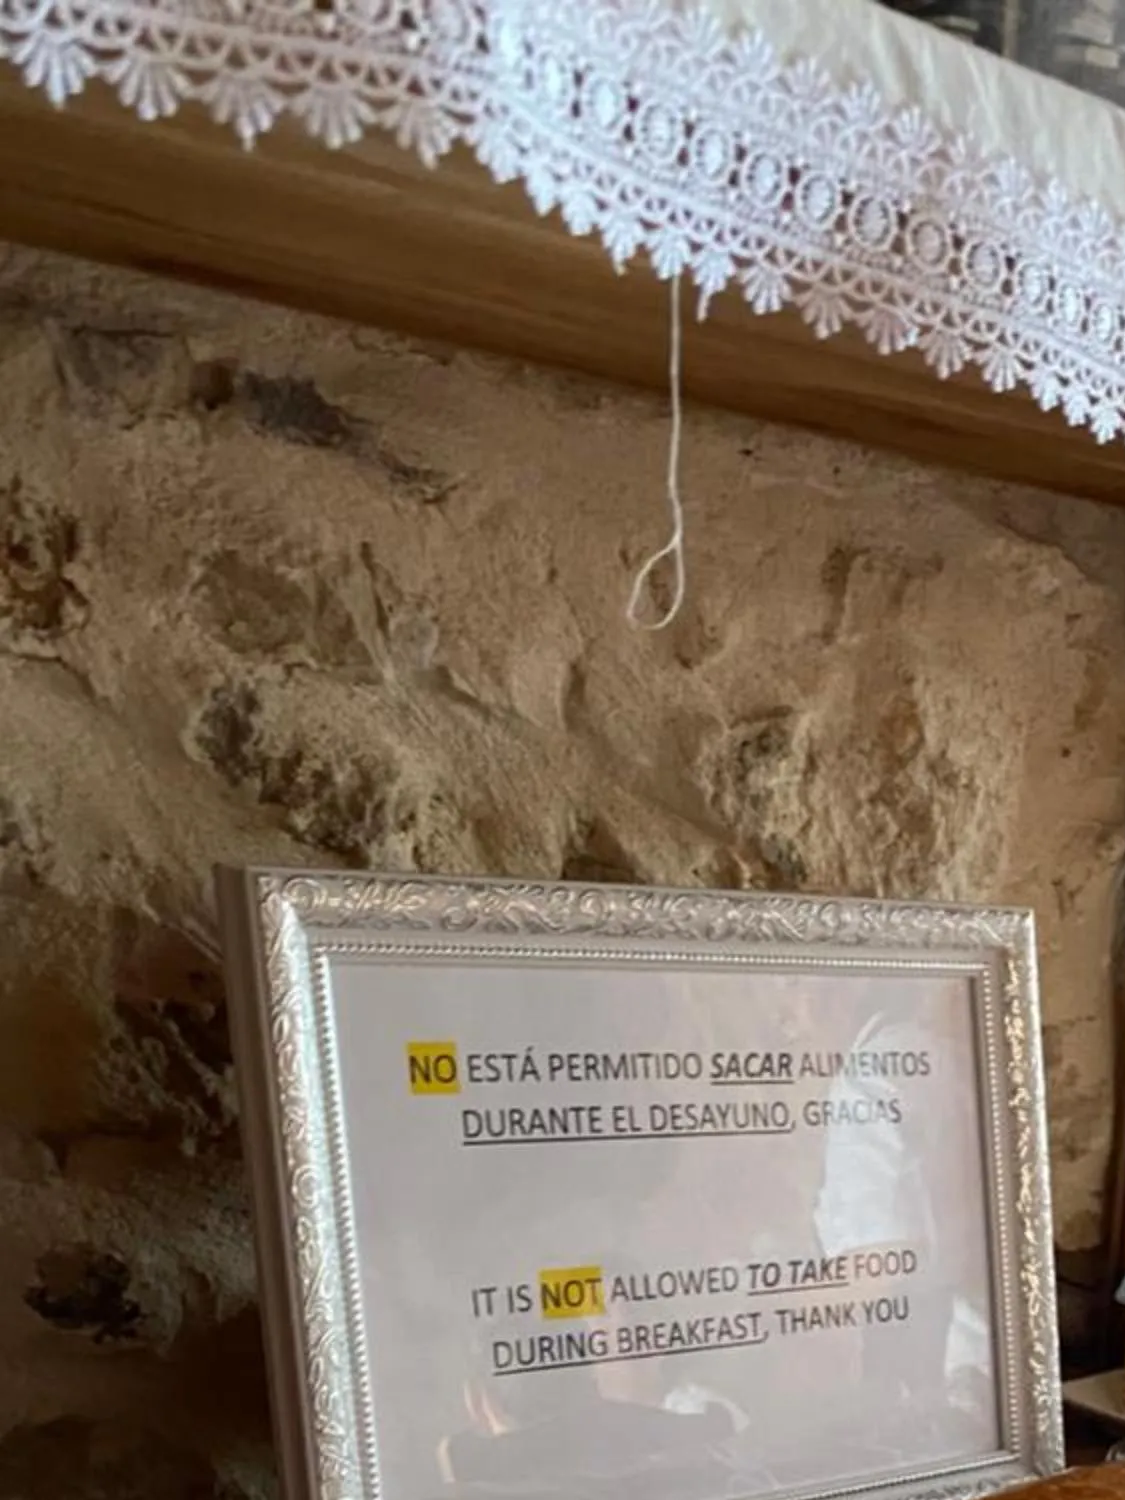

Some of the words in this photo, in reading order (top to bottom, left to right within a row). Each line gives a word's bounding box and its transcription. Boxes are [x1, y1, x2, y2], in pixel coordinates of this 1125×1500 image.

[408, 1054, 458, 1085] NO
[467, 1046, 541, 1083] ESTÁ
[548, 1052, 703, 1082] PERMITIDO
[709, 1052, 794, 1081] SACAR
[799, 1051, 931, 1078] ALIMENTOS
[462, 1106, 603, 1140] DURANTE
[612, 1105, 642, 1133] EL
[650, 1101, 797, 1133] DESAYUNO,
[803, 1099, 903, 1127] GRACIAS
[472, 1287, 497, 1317] IT
[508, 1284, 533, 1314] IS
[541, 1277, 602, 1310] NOT
[610, 1266, 739, 1303] ALLOWED
[749, 1262, 781, 1289] TO
[787, 1256, 847, 1285] TAKE
[854, 1249, 918, 1280] FOOD
[492, 1329, 608, 1369] DURING
[616, 1311, 769, 1354] BREAKFAST,
[774, 1301, 857, 1336] THANK
[861, 1296, 909, 1324] YOU
